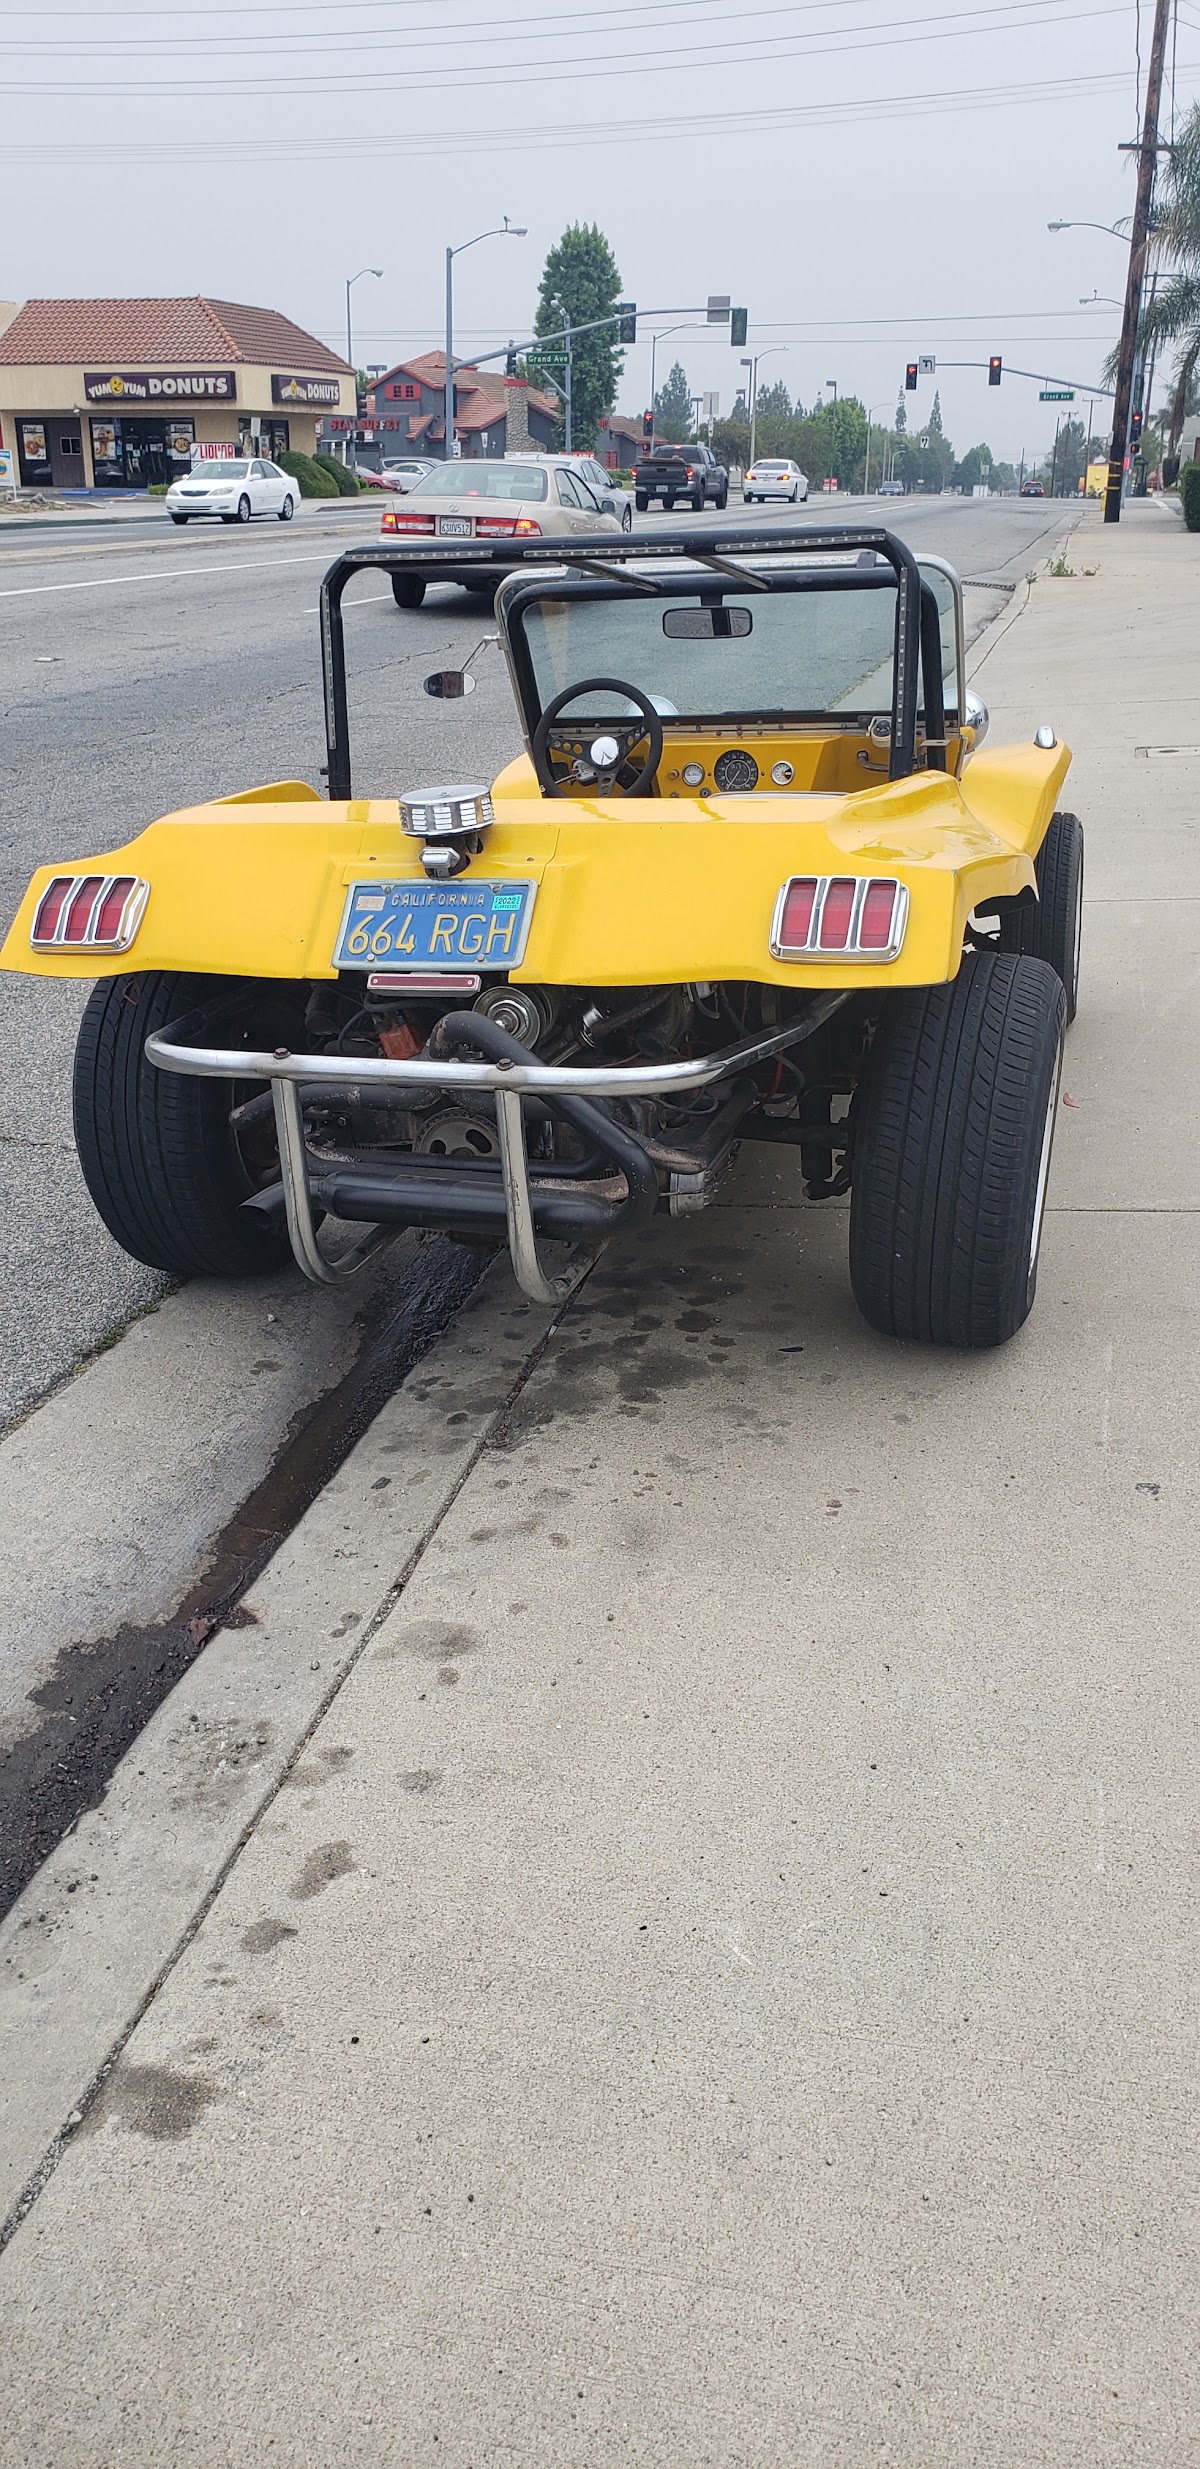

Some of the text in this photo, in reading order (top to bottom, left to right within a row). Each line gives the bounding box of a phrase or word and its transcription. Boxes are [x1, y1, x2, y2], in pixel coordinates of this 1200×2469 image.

[528, 355, 568, 363] Grand Ave
[88, 382, 146, 398] YUM YUM
[148, 377, 228, 394] DONUTS
[307, 383, 339, 400] DONUTS
[360, 418, 399, 431] BUFFET
[391, 893, 486, 907] CALIFORNIA
[347, 913, 516, 955] 664 RGH
